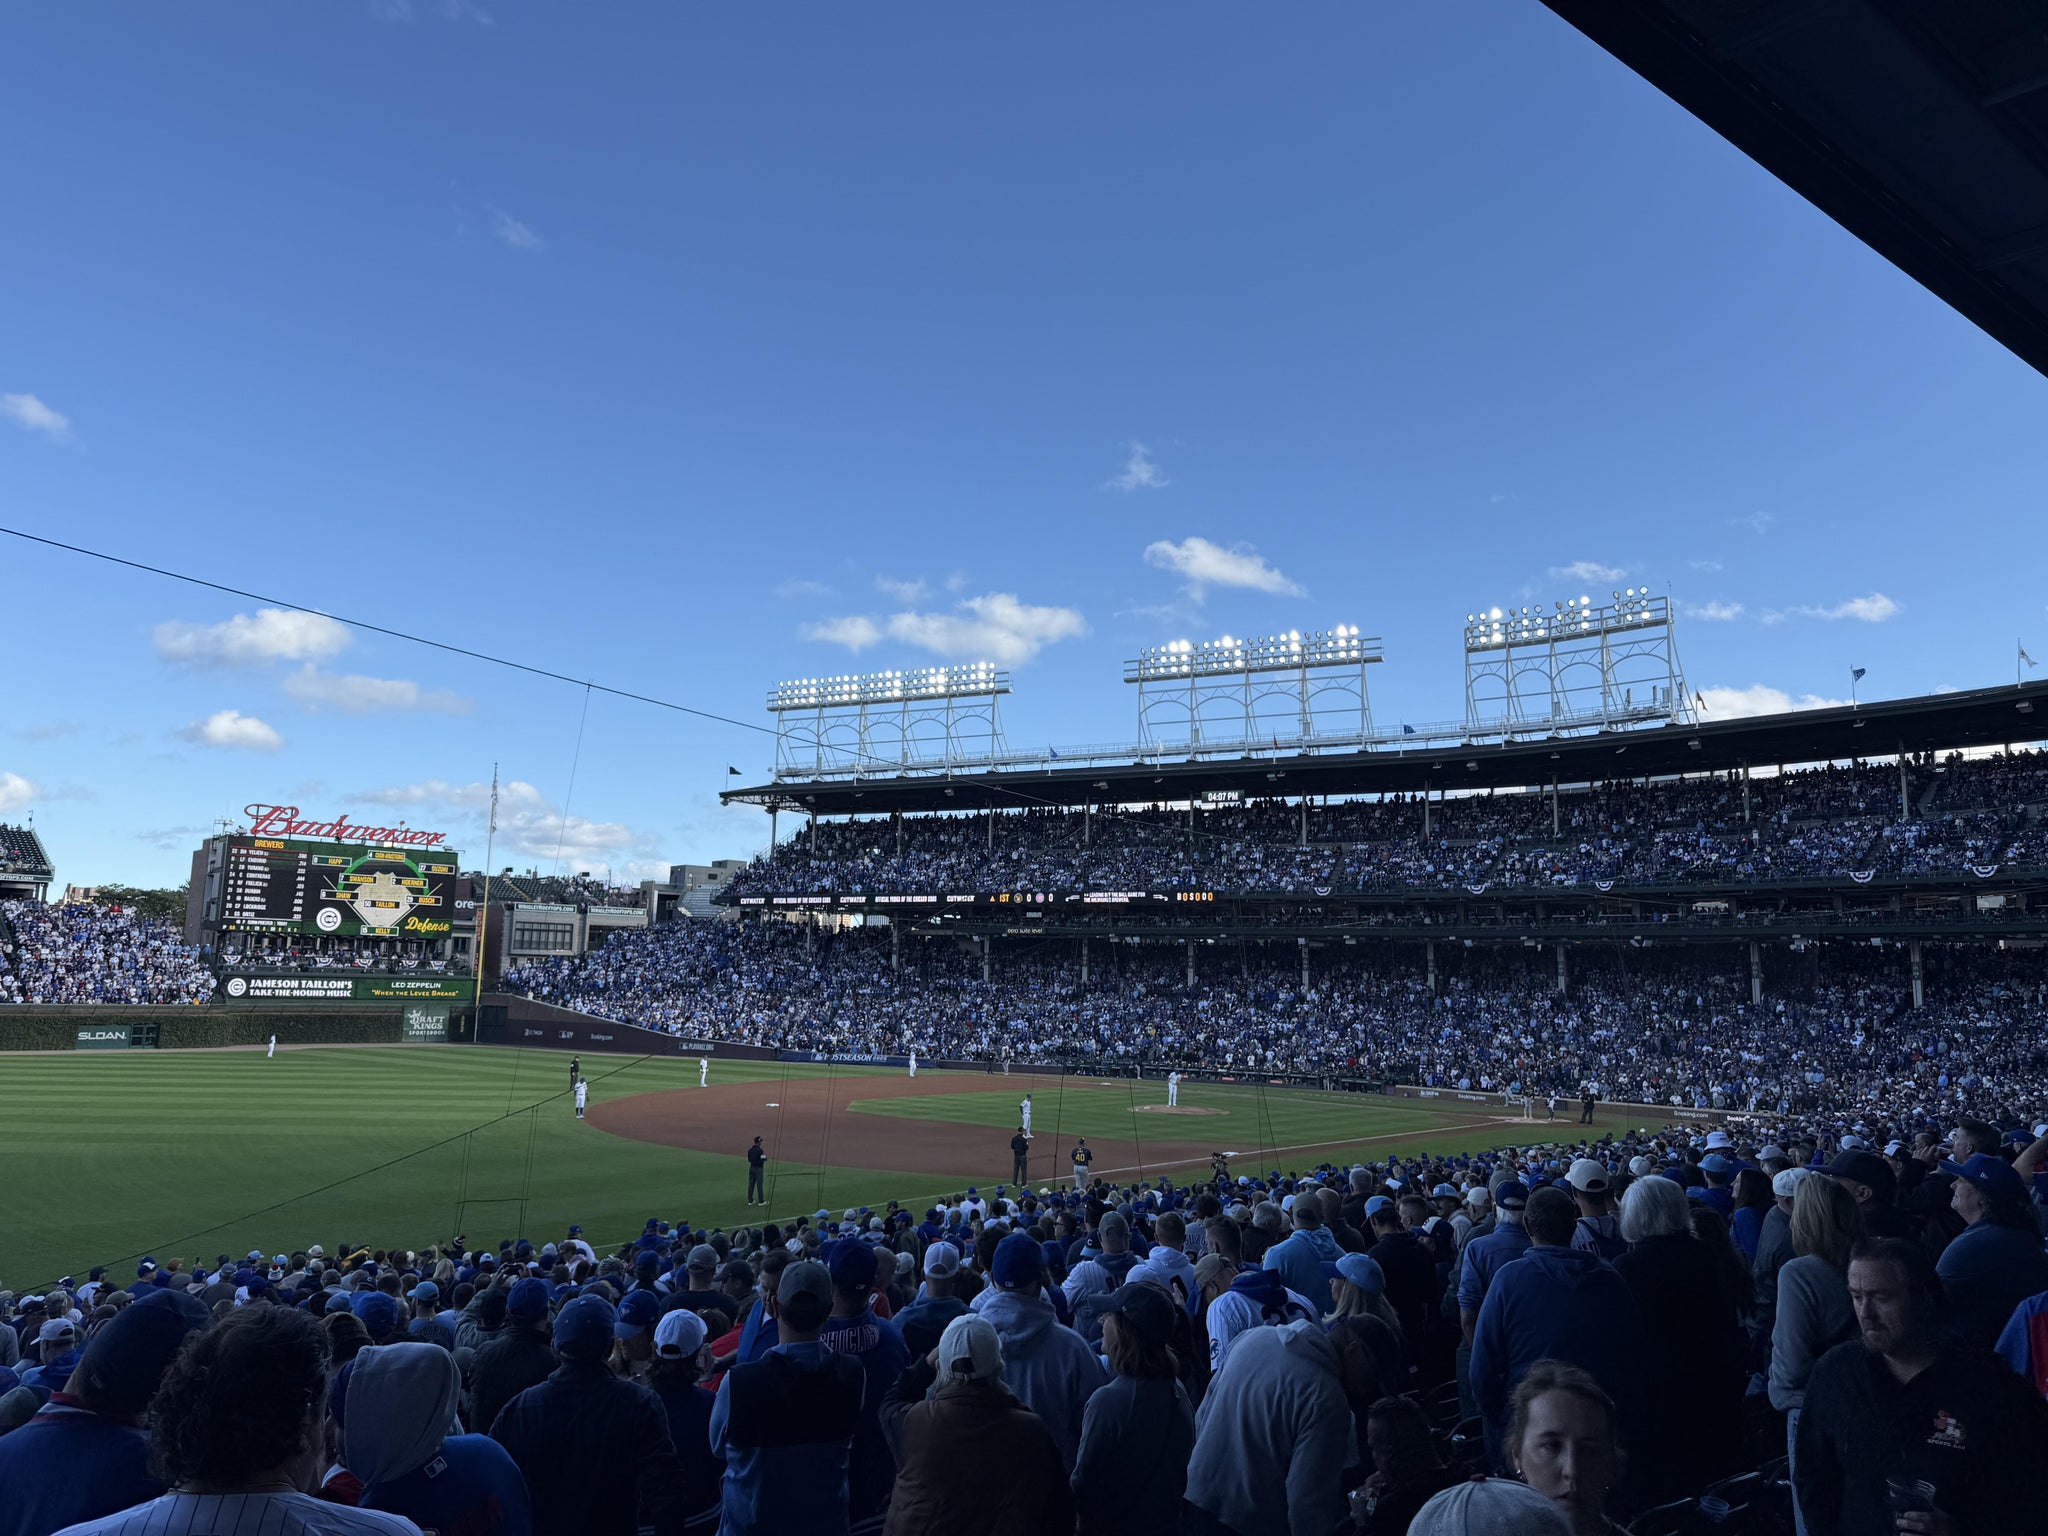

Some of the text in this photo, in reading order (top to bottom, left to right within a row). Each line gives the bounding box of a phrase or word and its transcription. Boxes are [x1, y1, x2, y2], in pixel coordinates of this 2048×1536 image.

[1208, 792, 1238, 801] 04:07 PM
[244, 804, 446, 845] Budweiser
[254, 839, 284, 849] BREWERS
[1000, 893, 1053, 902] 1ST 0 0
[1183, 893, 1188, 901] 0
[1208, 893, 1213, 901] 0
[455, 900, 474, 909] ore
[405, 916, 450, 931] Defense
[250, 979, 299, 988] JAMESON
[301, 980, 352, 989] TAILLON'S
[410, 1016, 445, 1024] DRAFT
[1076, 1153, 1085, 1161] 40
